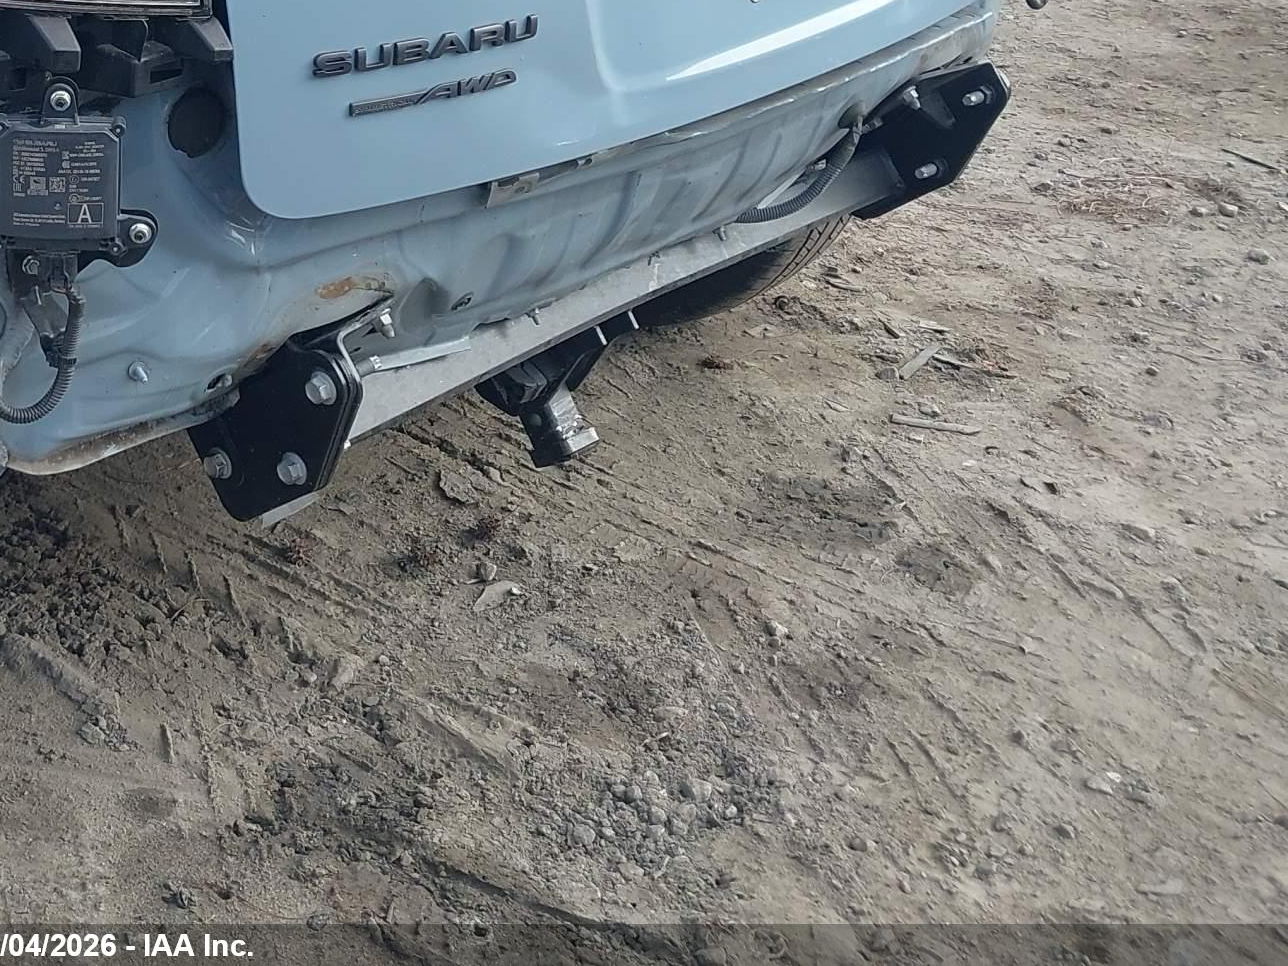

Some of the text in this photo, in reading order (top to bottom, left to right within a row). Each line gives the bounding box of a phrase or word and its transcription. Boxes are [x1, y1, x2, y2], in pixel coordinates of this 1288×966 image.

[312, 14, 539, 78] SUBARU
[412, 68, 518, 105] AWD
[77, 204, 93, 224] A
